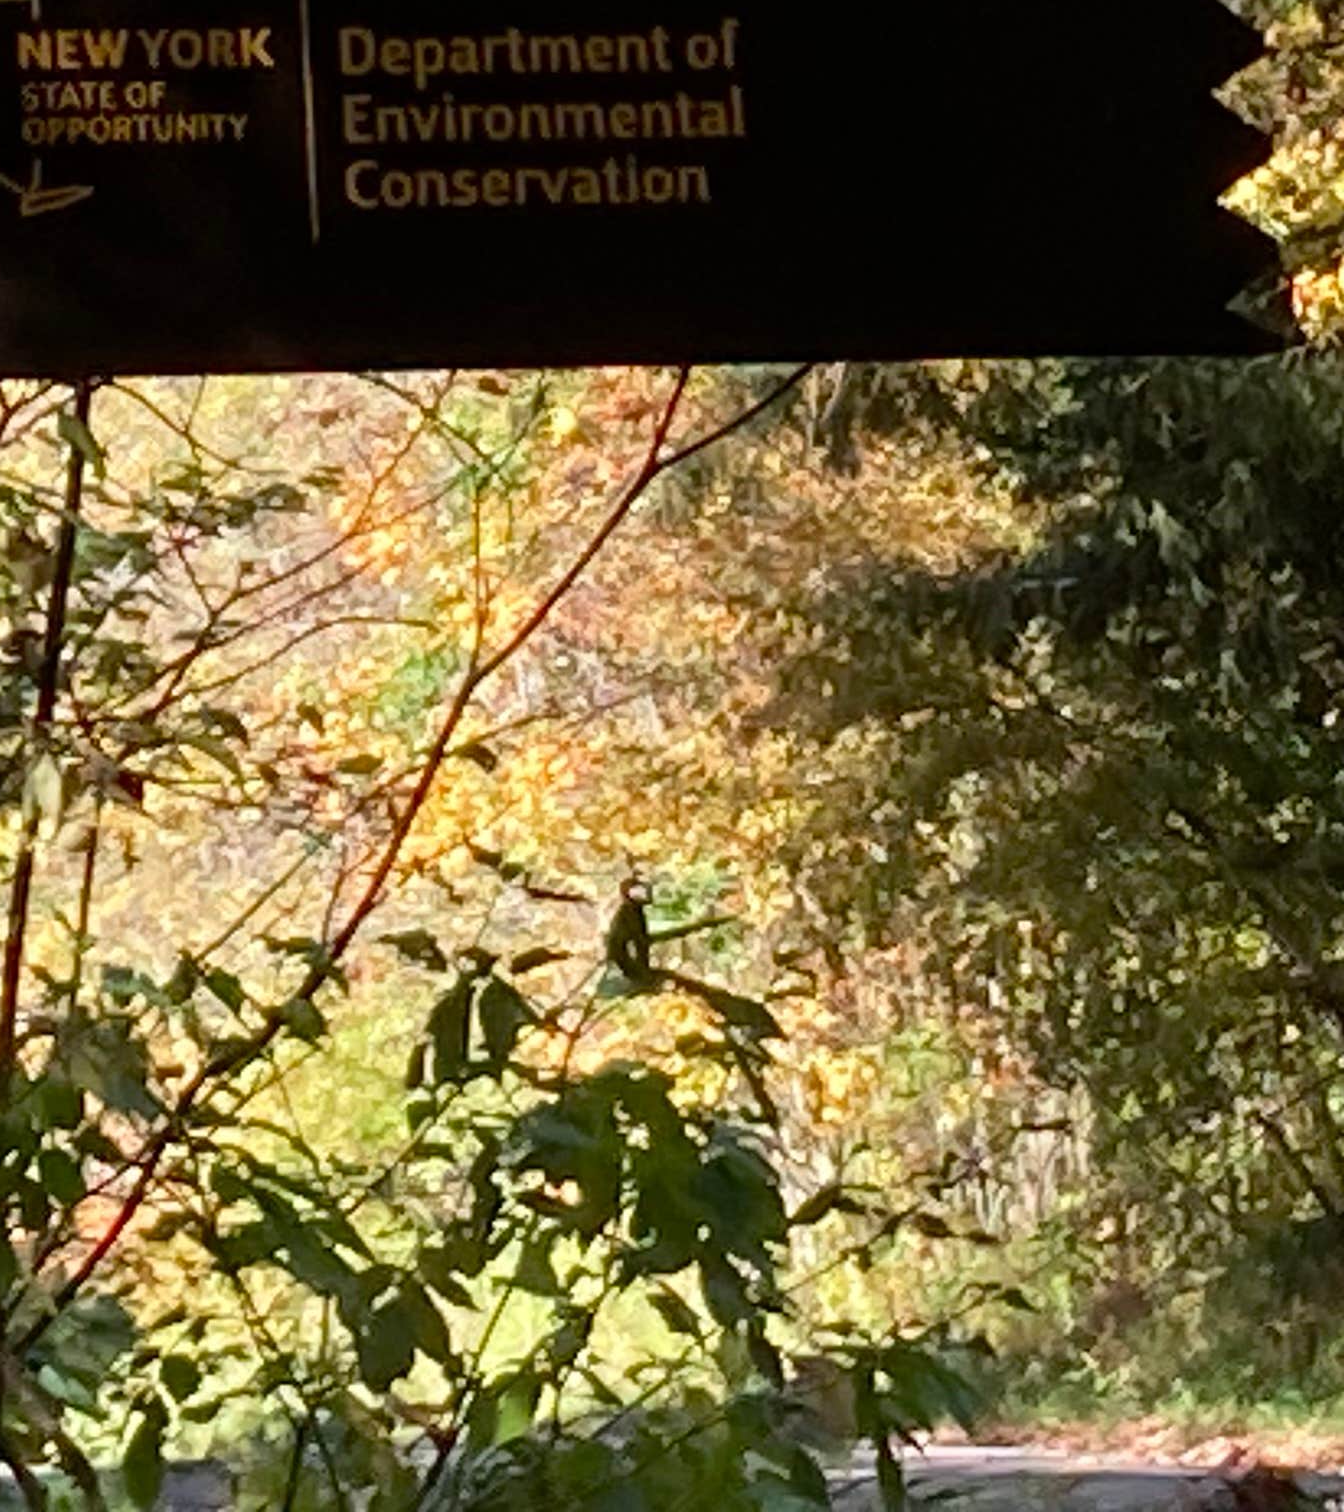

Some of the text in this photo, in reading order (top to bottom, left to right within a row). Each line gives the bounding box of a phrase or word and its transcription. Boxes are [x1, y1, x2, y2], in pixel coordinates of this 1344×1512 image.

[19, 28, 274, 69] NEW YORK
[339, 18, 739, 85] Department of
[21, 82, 164, 108] STATE OF
[343, 90, 744, 142] Environmental
[23, 113, 246, 143] OPPORTUNITY
[345, 156, 710, 209] Conservation
